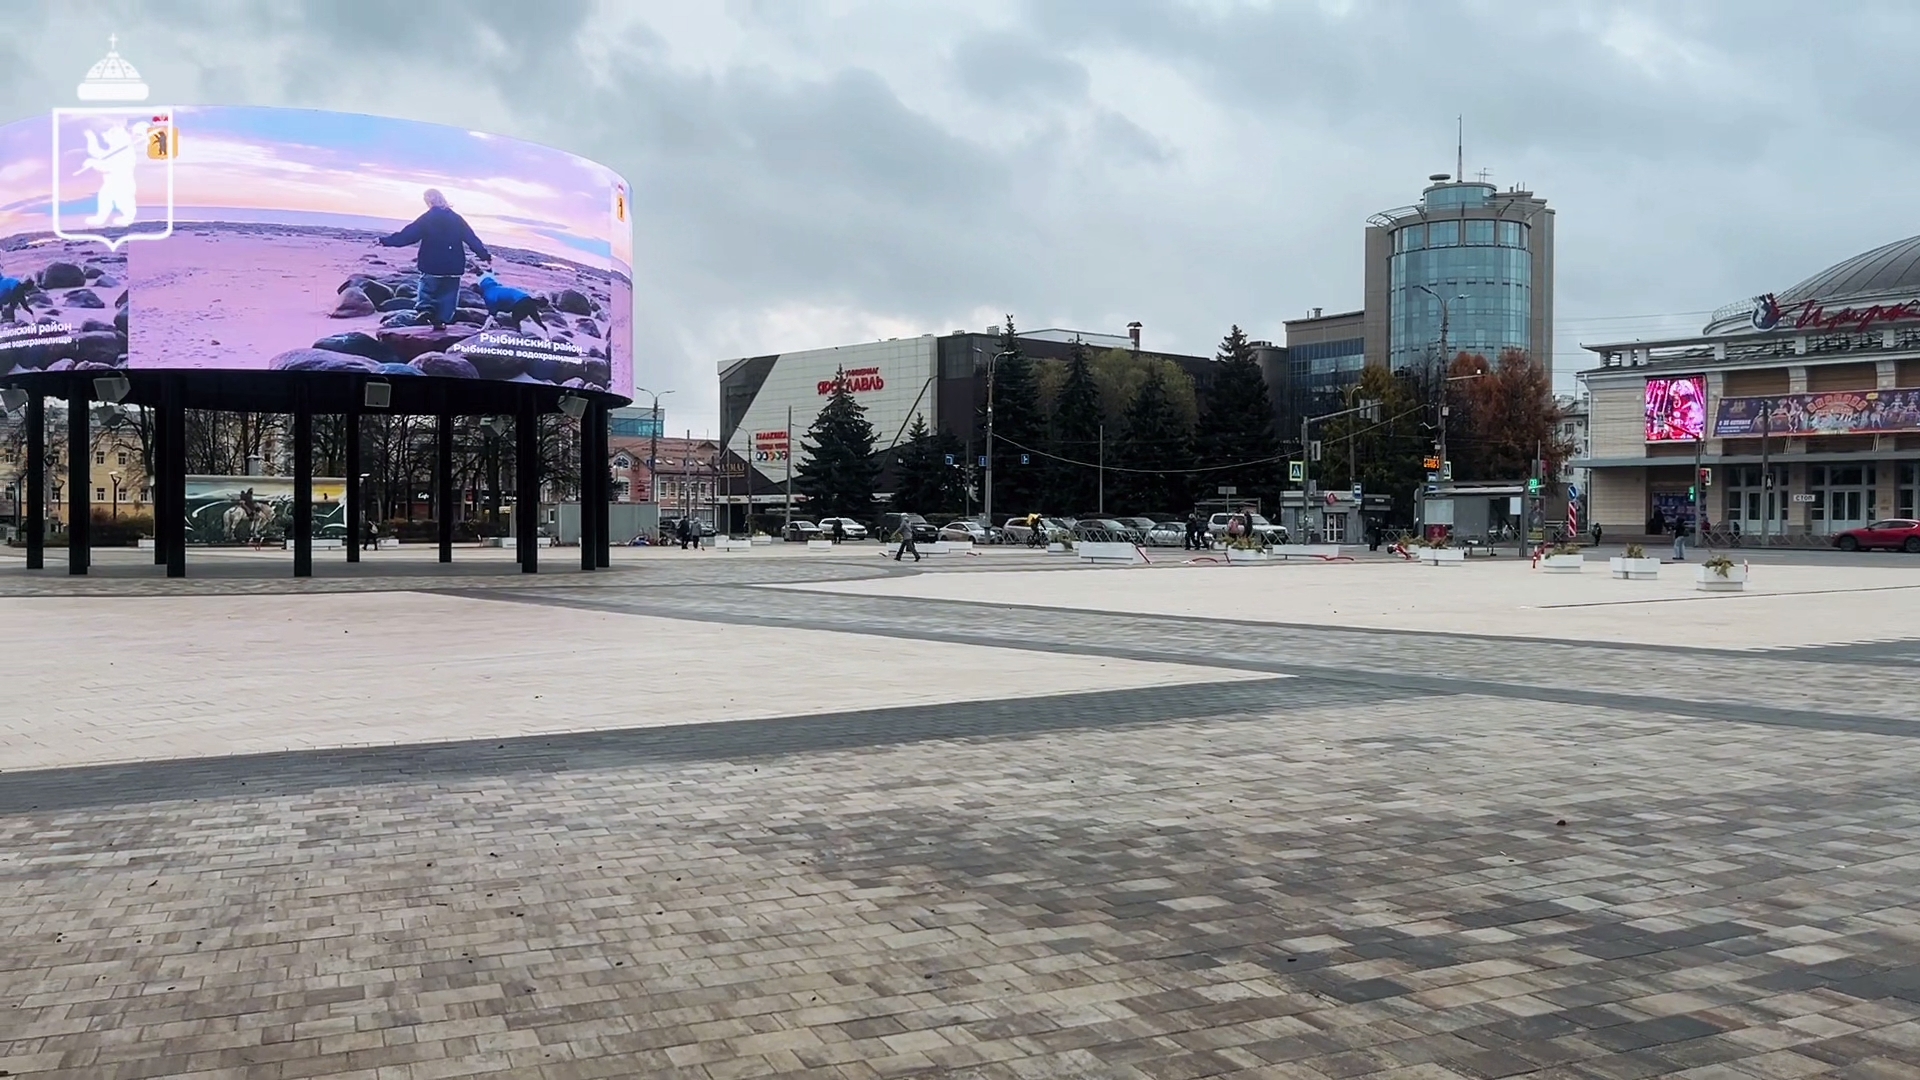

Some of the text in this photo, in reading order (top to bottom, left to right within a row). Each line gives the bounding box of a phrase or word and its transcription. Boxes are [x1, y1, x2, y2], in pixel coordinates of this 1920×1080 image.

[39, 321, 72, 335] район
[453, 343, 514, 357] Рыбинское
[480, 333, 583, 354] Рыбинский район
[817, 376, 885, 395] ЯРОЛАВЛЬ
